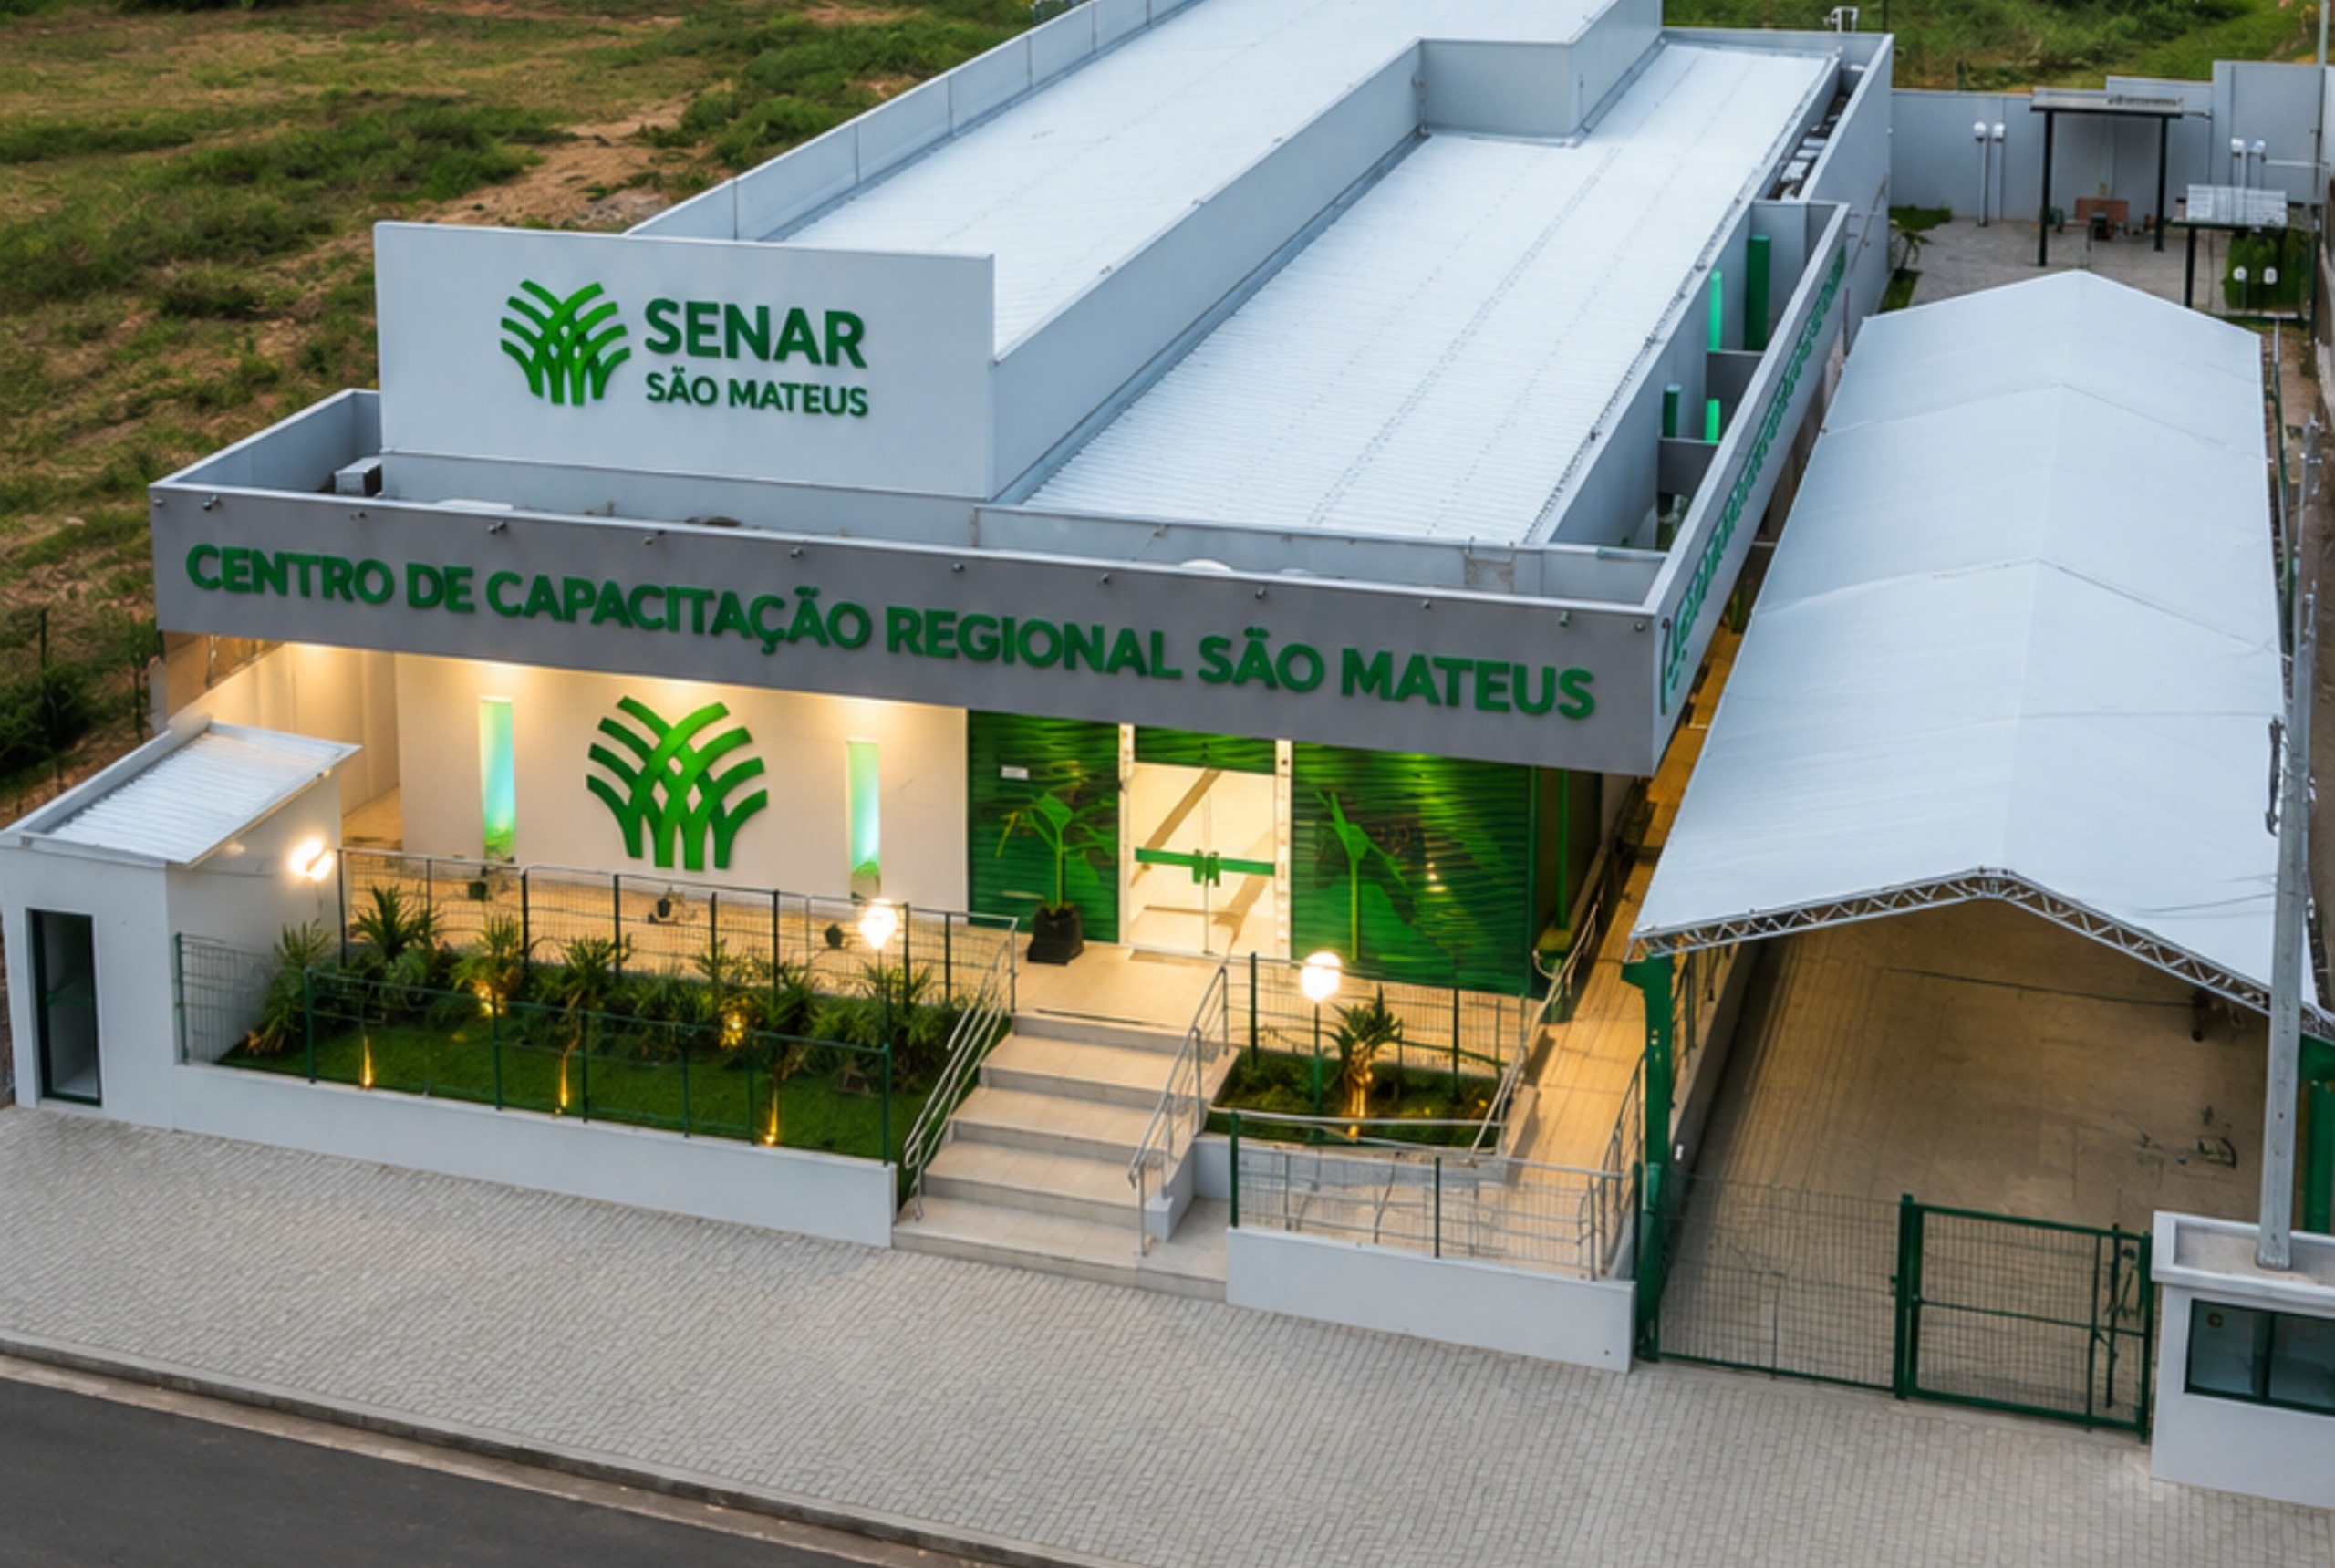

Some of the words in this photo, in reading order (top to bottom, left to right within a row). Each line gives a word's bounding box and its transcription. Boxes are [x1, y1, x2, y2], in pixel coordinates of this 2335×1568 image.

[645, 298, 868, 369] SENAR
[727, 379, 869, 418] MATEUS
[185, 544, 395, 606] CENTRO
[405, 562, 477, 614] DE
[484, 570, 873, 655] CAPACITAÇÃO
[885, 605, 1184, 680] REGIONAL
[1197, 627, 1326, 693] SÃO
[1340, 647, 1596, 720] MATEUS
